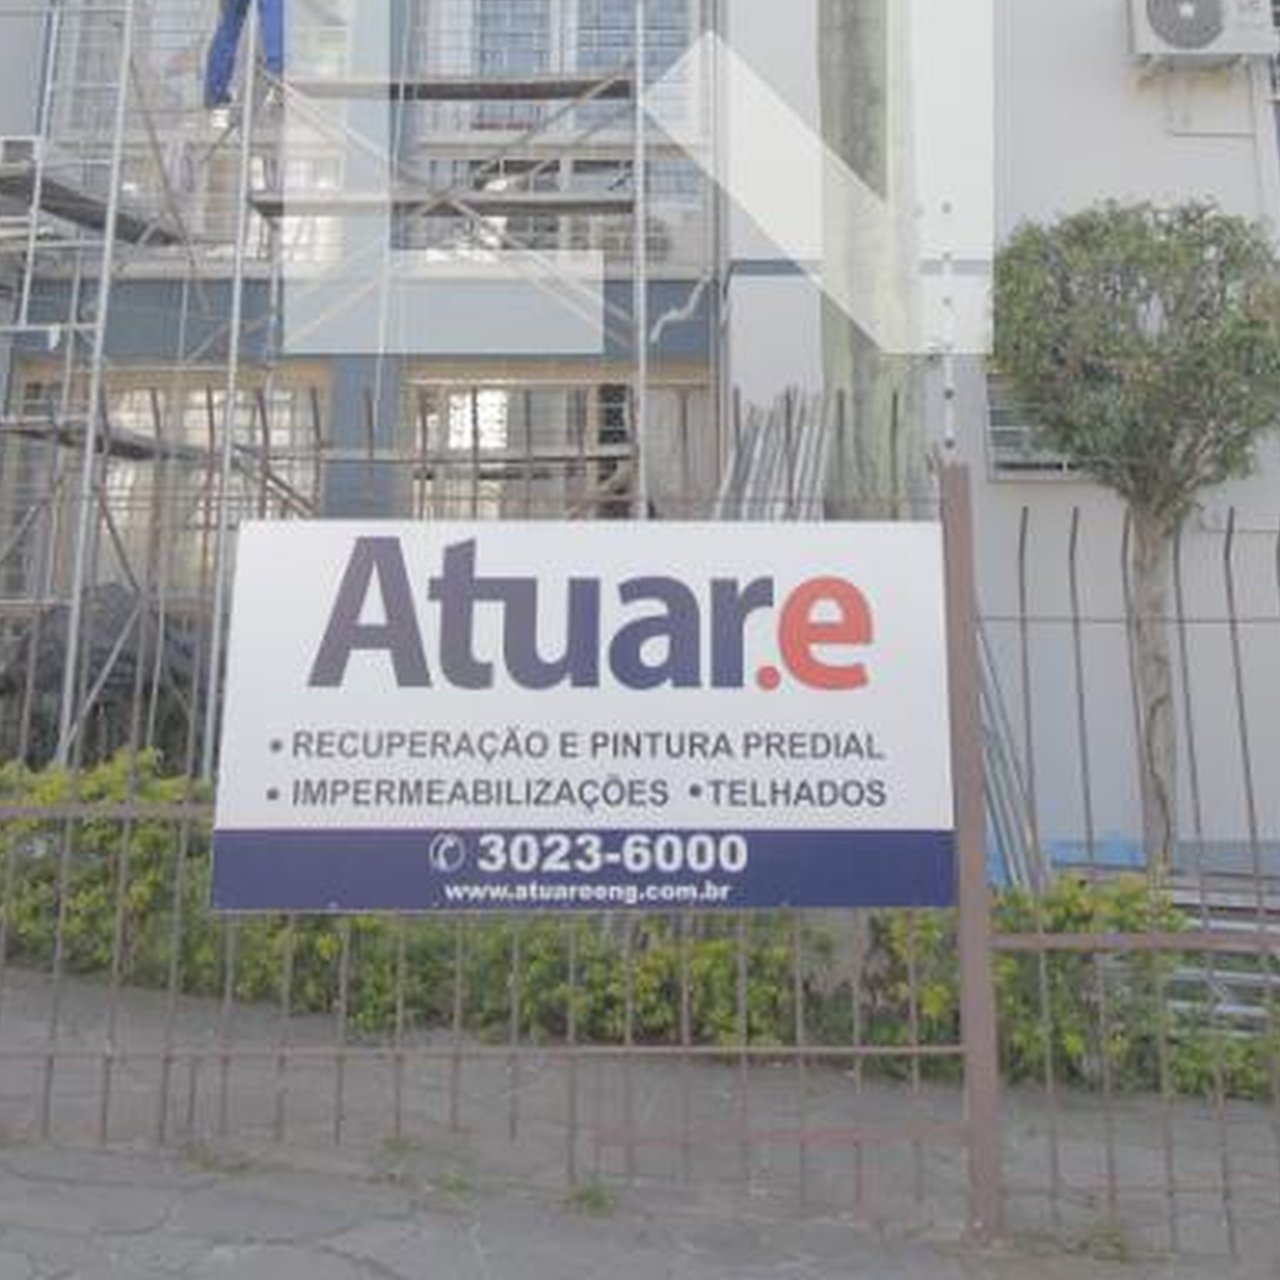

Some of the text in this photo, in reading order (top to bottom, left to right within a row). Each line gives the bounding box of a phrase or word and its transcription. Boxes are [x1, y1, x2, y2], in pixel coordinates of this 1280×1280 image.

[307, 536, 875, 692] Atuar.e
[292, 726, 887, 762] RECUPERAÇÃO E PINTURA PREDIAL
[292, 774, 887, 813] IMPERMEABILIZAÇÕES TELHADOS
[477, 833, 749, 871] 3023-6000
[444, 880, 732, 904] www.atuareeng.com.br
